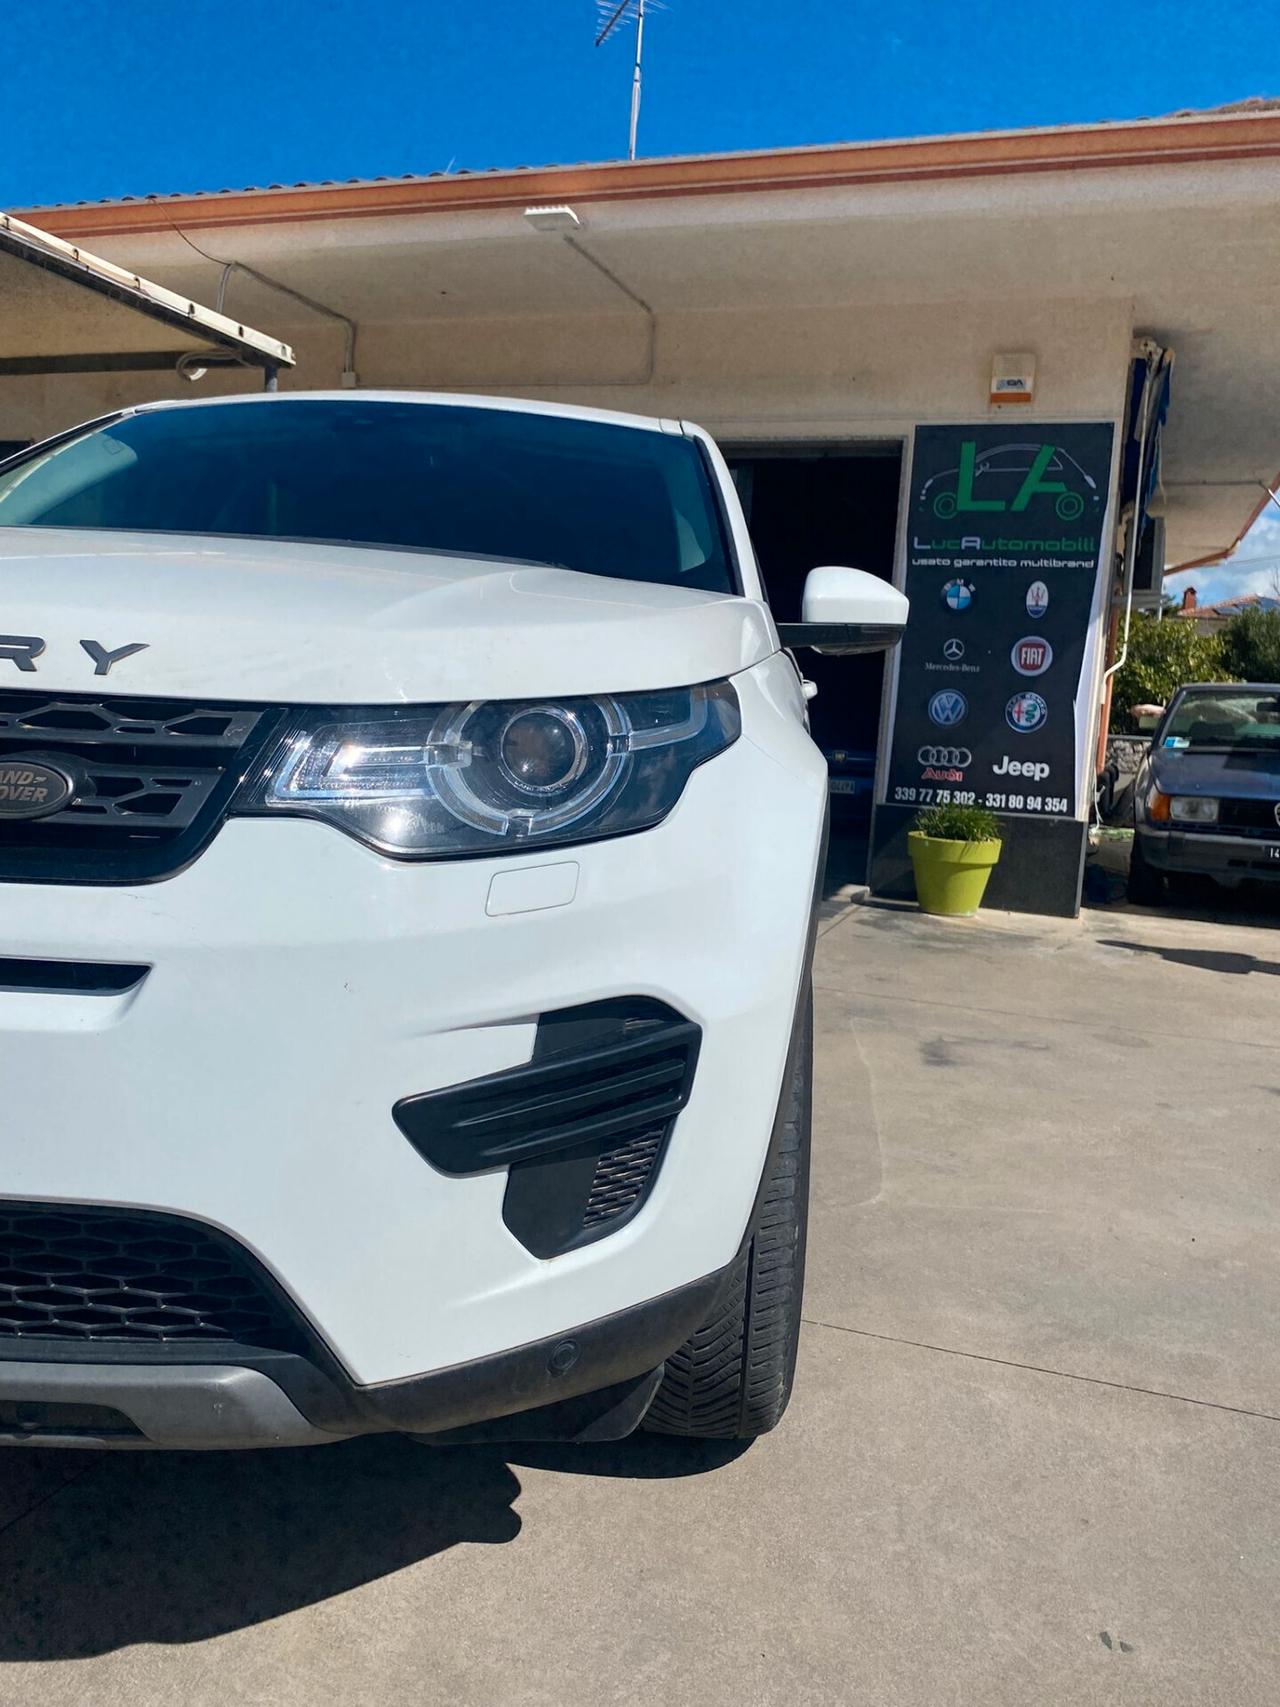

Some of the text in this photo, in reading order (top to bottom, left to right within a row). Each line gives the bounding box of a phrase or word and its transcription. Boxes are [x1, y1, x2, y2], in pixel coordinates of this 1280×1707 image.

[913, 536, 1096, 551] LucAutomobili
[912, 558, 1095, 569] usato garantito multibrand
[1021, 647, 1044, 666] FIAT
[925, 662, 980, 673] Mercedes-Benz
[921, 767, 963, 782] Audi
[992, 756, 1050, 781] Jeep
[895, 787, 916, 800] 339
[919, 789, 933, 801] 77
[936, 789, 950, 804] 75
[953, 791, 976, 805] 302
[985, 793, 1006, 808] 331
[1008, 795, 1024, 810] 80
[1026, 796, 1042, 811] 94
[1044, 797, 1068, 813] 354
